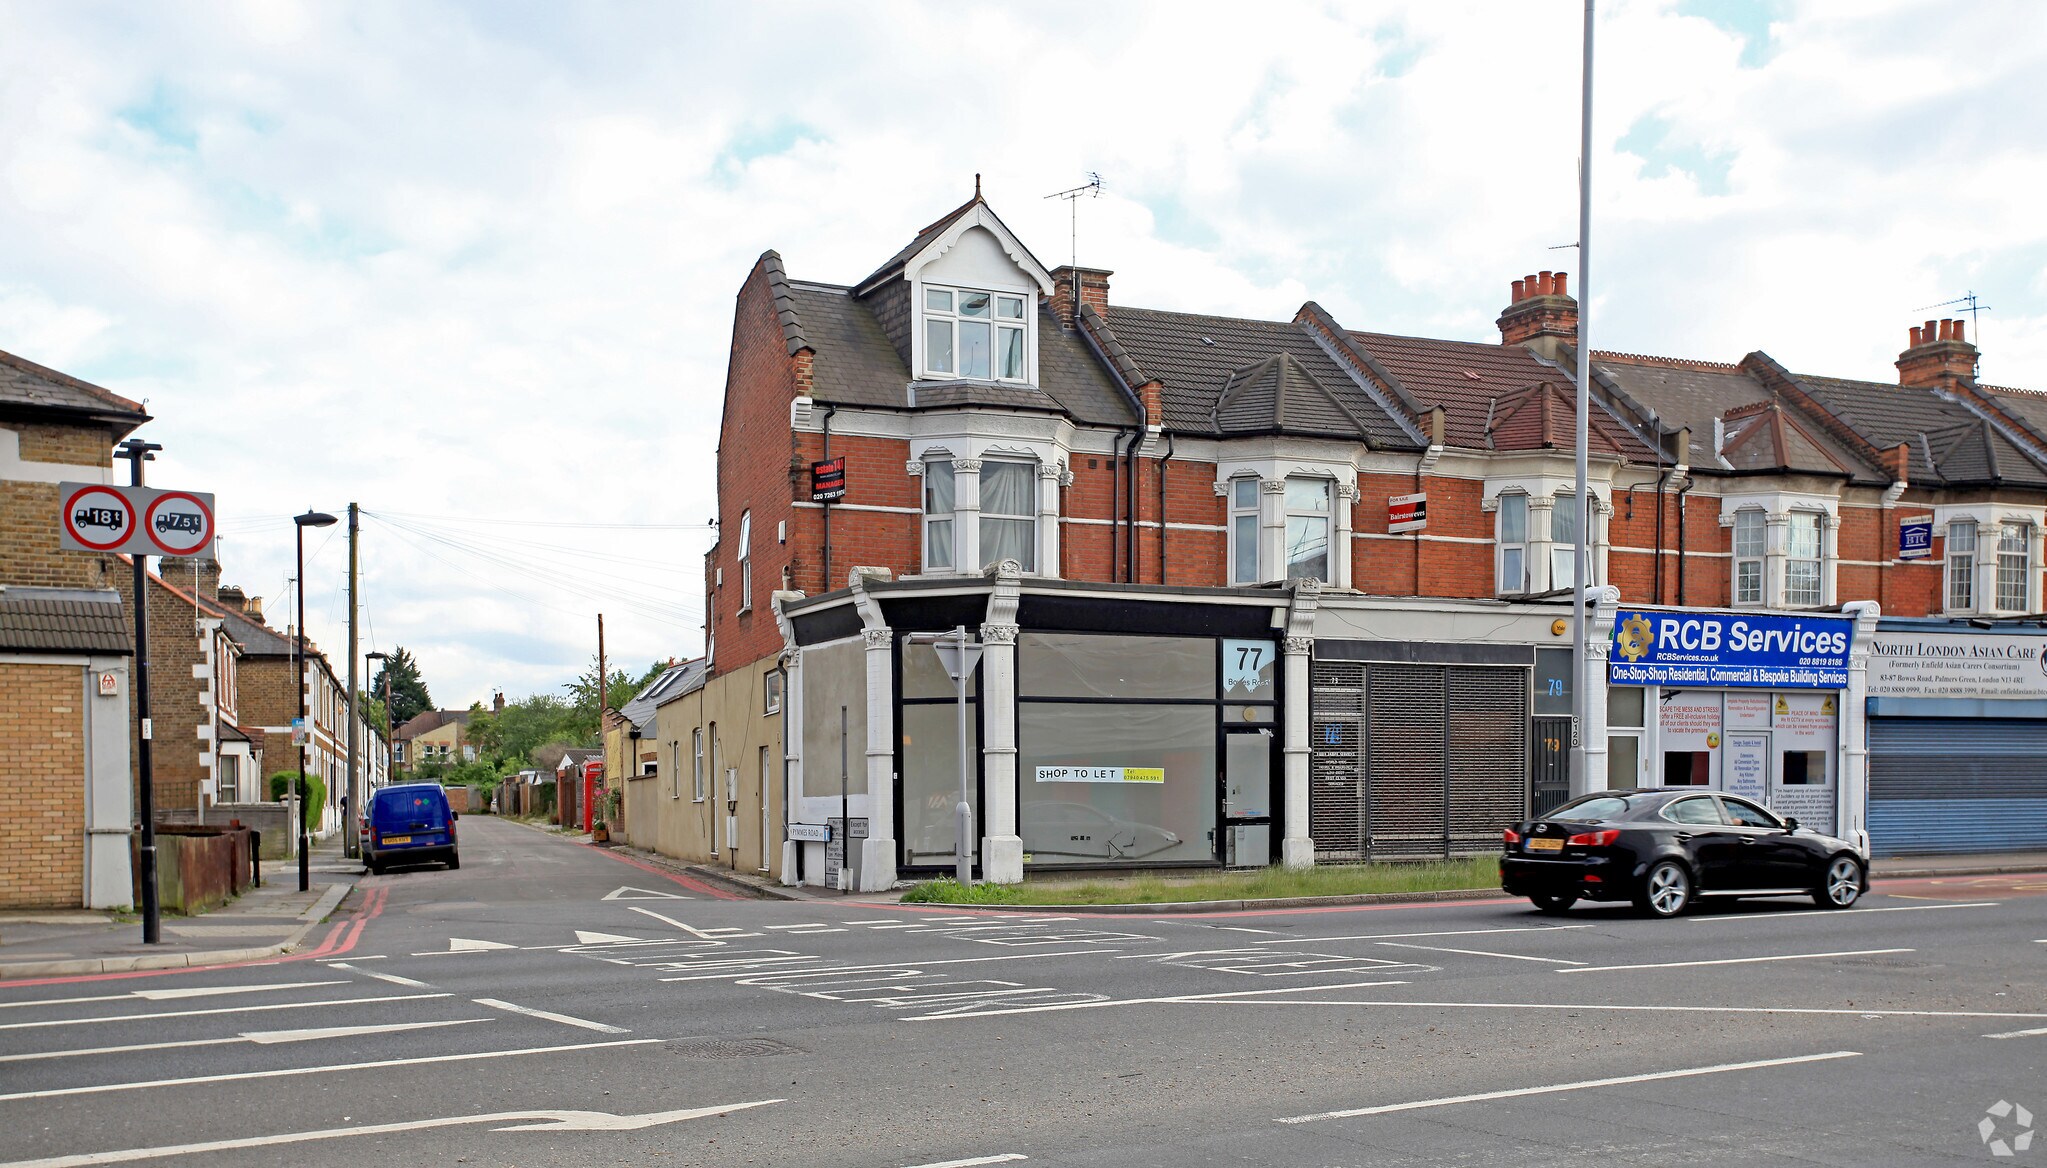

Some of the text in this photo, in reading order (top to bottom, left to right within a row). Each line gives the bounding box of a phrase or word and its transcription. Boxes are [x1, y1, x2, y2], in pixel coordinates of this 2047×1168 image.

[816, 479, 844, 490] MANAGED
[1658, 619, 1846, 654] RCB Services
[1872, 641, 2036, 659] NORTH LONDON ASIAN CARE
[1236, 647, 1263, 671] 77
[1656, 652, 1719, 662] RCBServices.co.uk
[1798, 657, 1843, 666] 020 8819 8186
[1888, 661, 1919, 670] (Formerly
[1921, 661, 1943, 669] Enfield
[1962, 662, 1982, 670] Carers
[1983, 662, 2020, 671] Consortium)
[1612, 665, 1847, 686] One-Stop-Shop Residential, Commercial & Bespoke Building Services
[1879, 674, 1897, 682] 83-87
[1917, 675, 1934, 683] Road,
[1228, 677, 1250, 686] Boes
[1548, 679, 1563, 696] 79
[1039, 769, 1116, 779] SHOP TO LET
